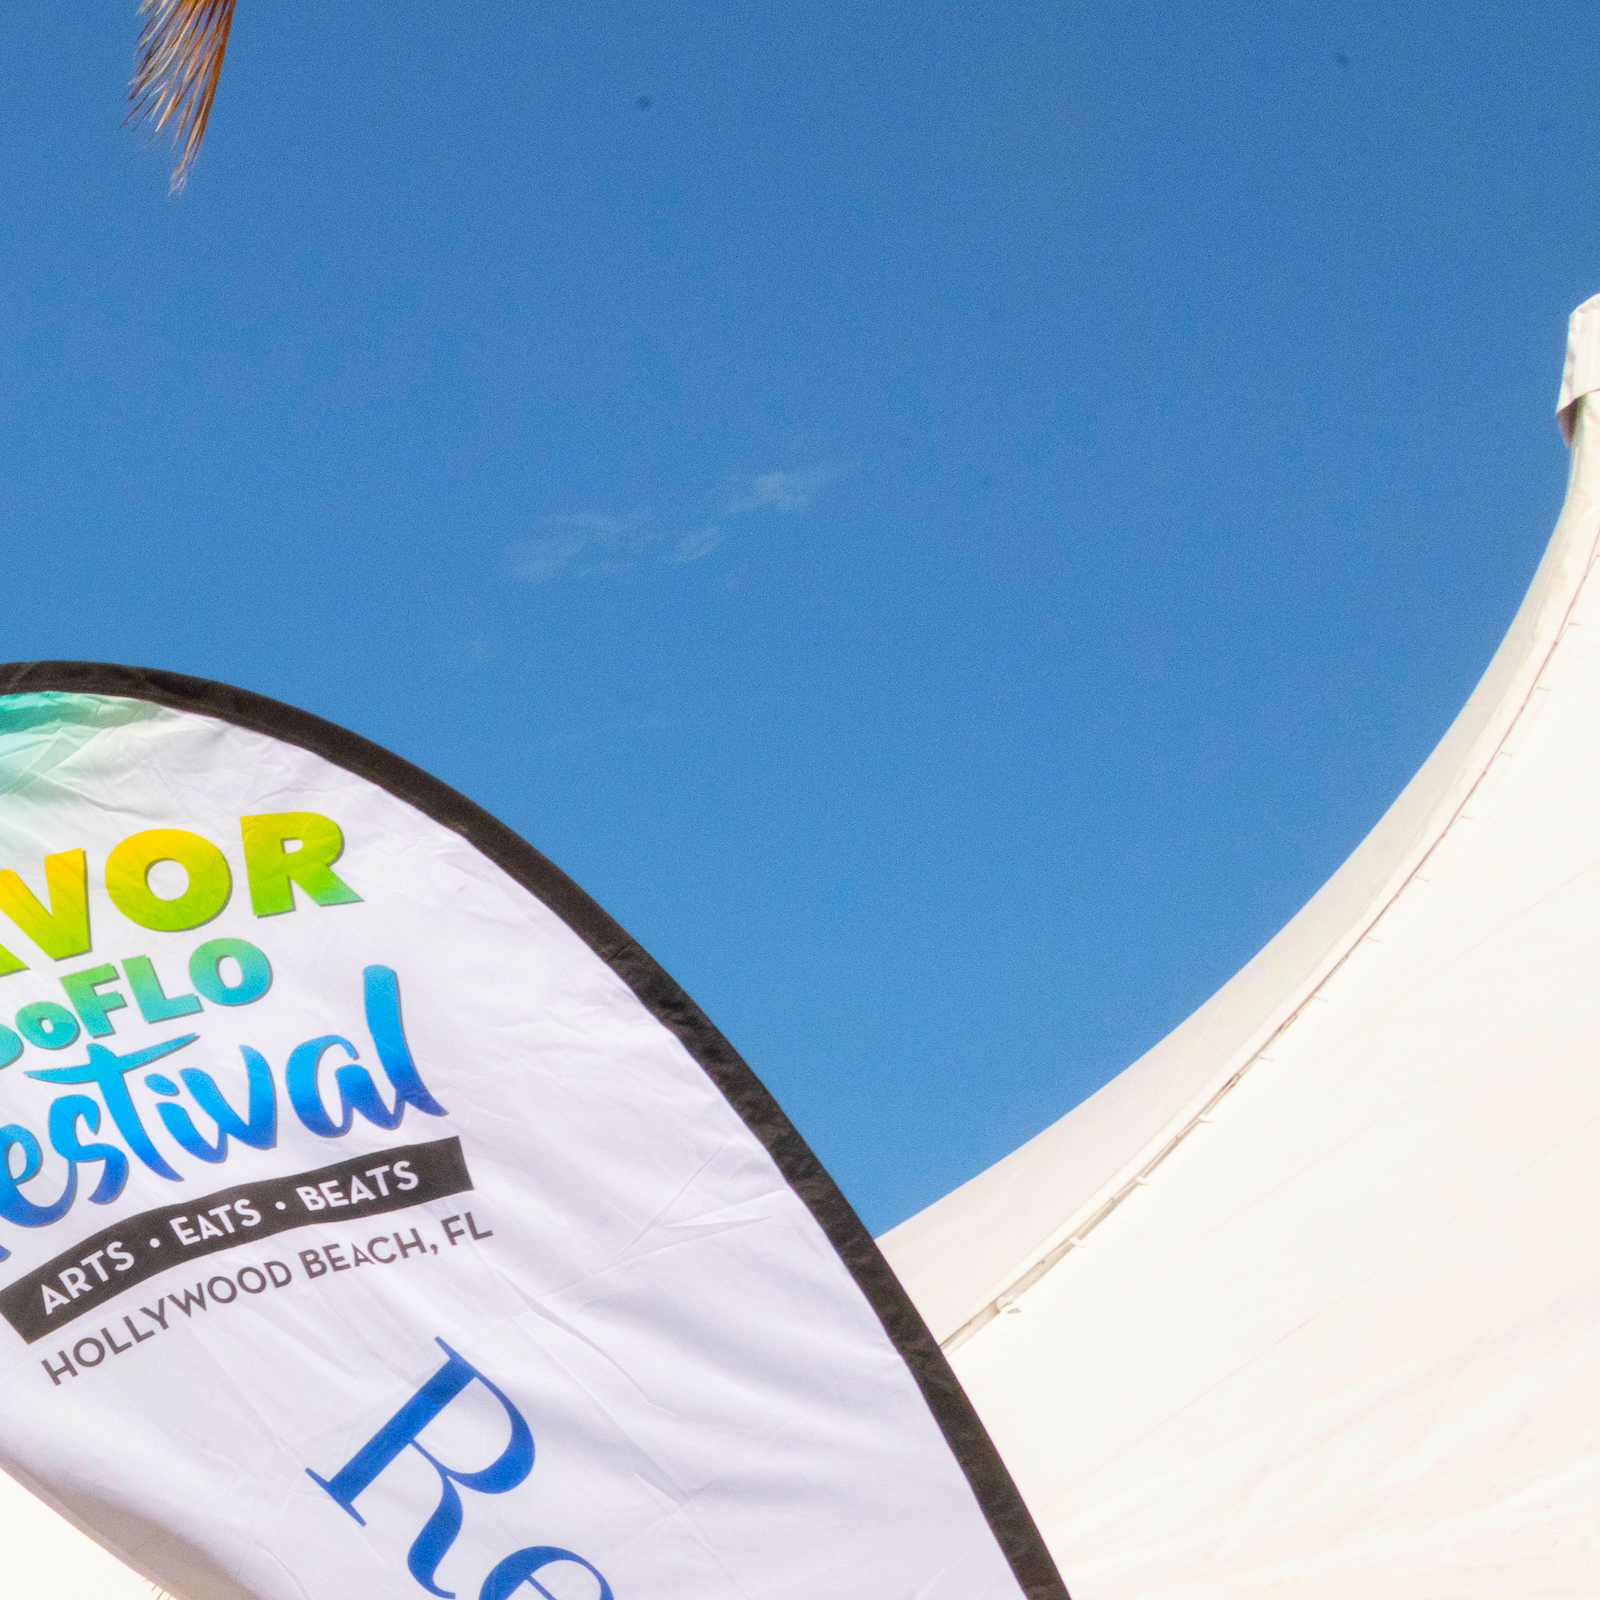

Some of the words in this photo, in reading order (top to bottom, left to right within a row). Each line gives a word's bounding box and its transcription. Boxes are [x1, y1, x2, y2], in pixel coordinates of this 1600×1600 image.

[40, 1260, 292, 1388] HOLLYWOOD
[298, 1225, 441, 1280] BEACH,
[446, 1211, 494, 1245] FL
[42, 1242, 136, 1316] ARTS
[169, 1199, 263, 1248] EATS
[296, 1160, 421, 1211] BEATS
